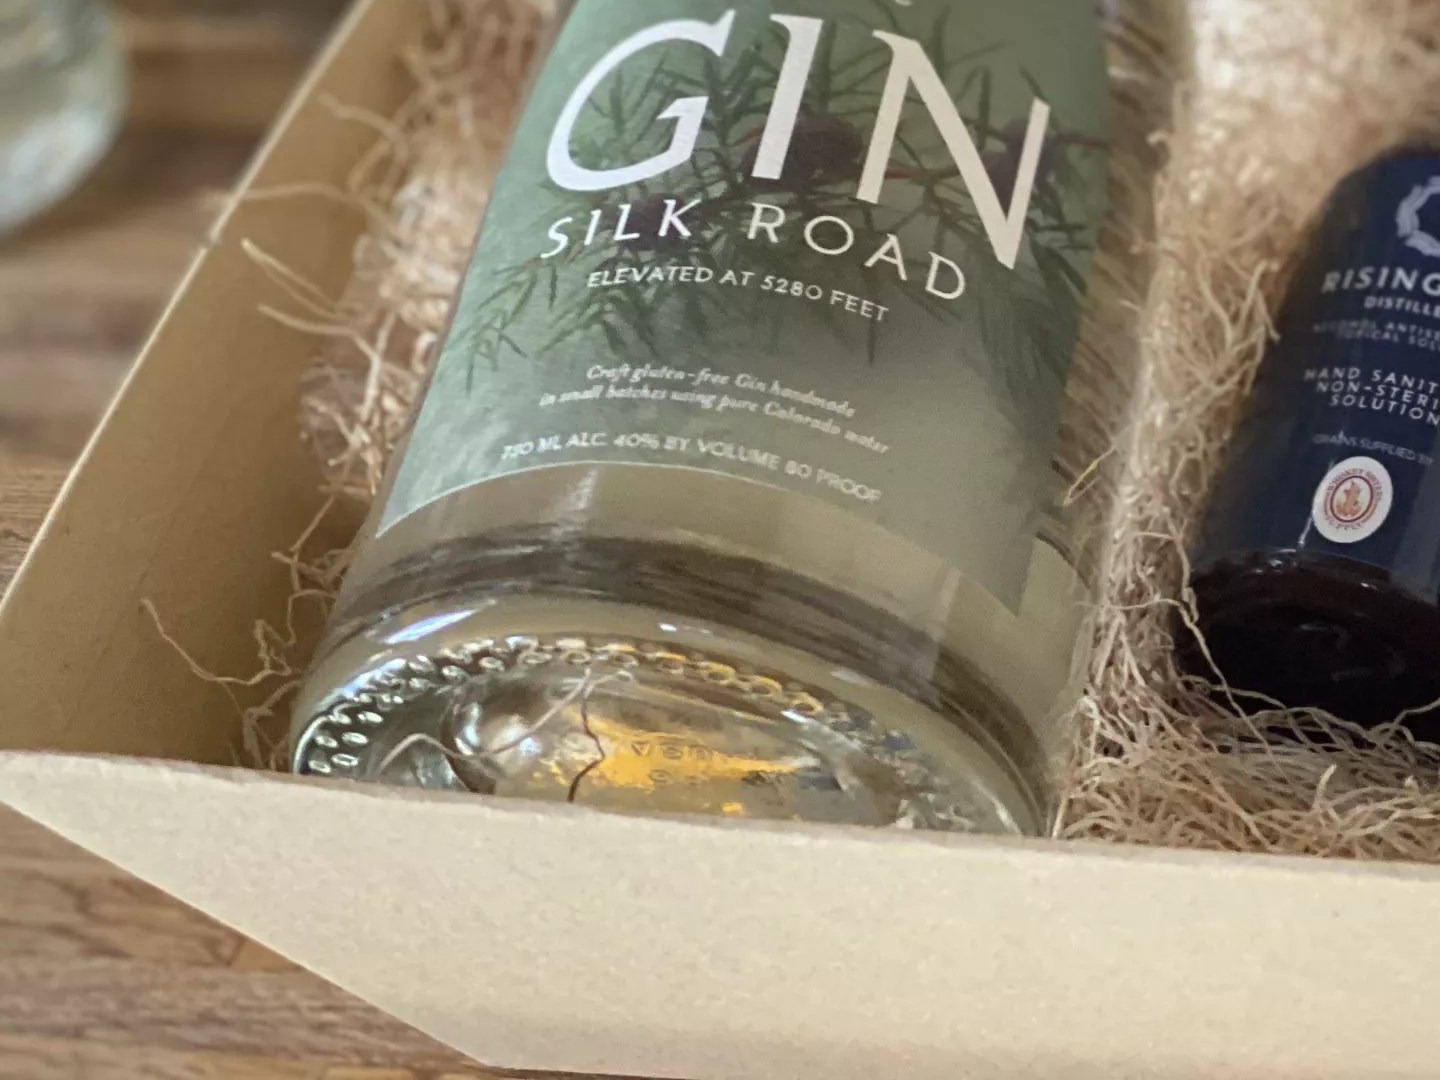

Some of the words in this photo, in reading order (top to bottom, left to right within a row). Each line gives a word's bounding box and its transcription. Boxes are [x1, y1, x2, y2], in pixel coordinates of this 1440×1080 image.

[547, 9, 1050, 269] GIN
[541, 198, 701, 259] SILK
[747, 202, 967, 300] ROAD
[587, 266, 713, 288] ELEVATED
[723, 270, 754, 287] AT
[761, 274, 822, 301] 5280
[830, 290, 889, 321] FEET
[587, 363, 629, 383] Craft
[734, 373, 767, 393] Gin
[1303, 367, 1360, 381] HAND
[763, 401, 842, 437] Colorado
[1328, 393, 1440, 426] SOLUTION
[537, 434, 563, 452] ML
[565, 431, 607, 448] ALC
[613, 432, 660, 450] 40%
[663, 435, 690, 452] BY
[696, 438, 781, 470] VOLUME
[785, 460, 813, 479] 80
[816, 469, 882, 502] PROOF
